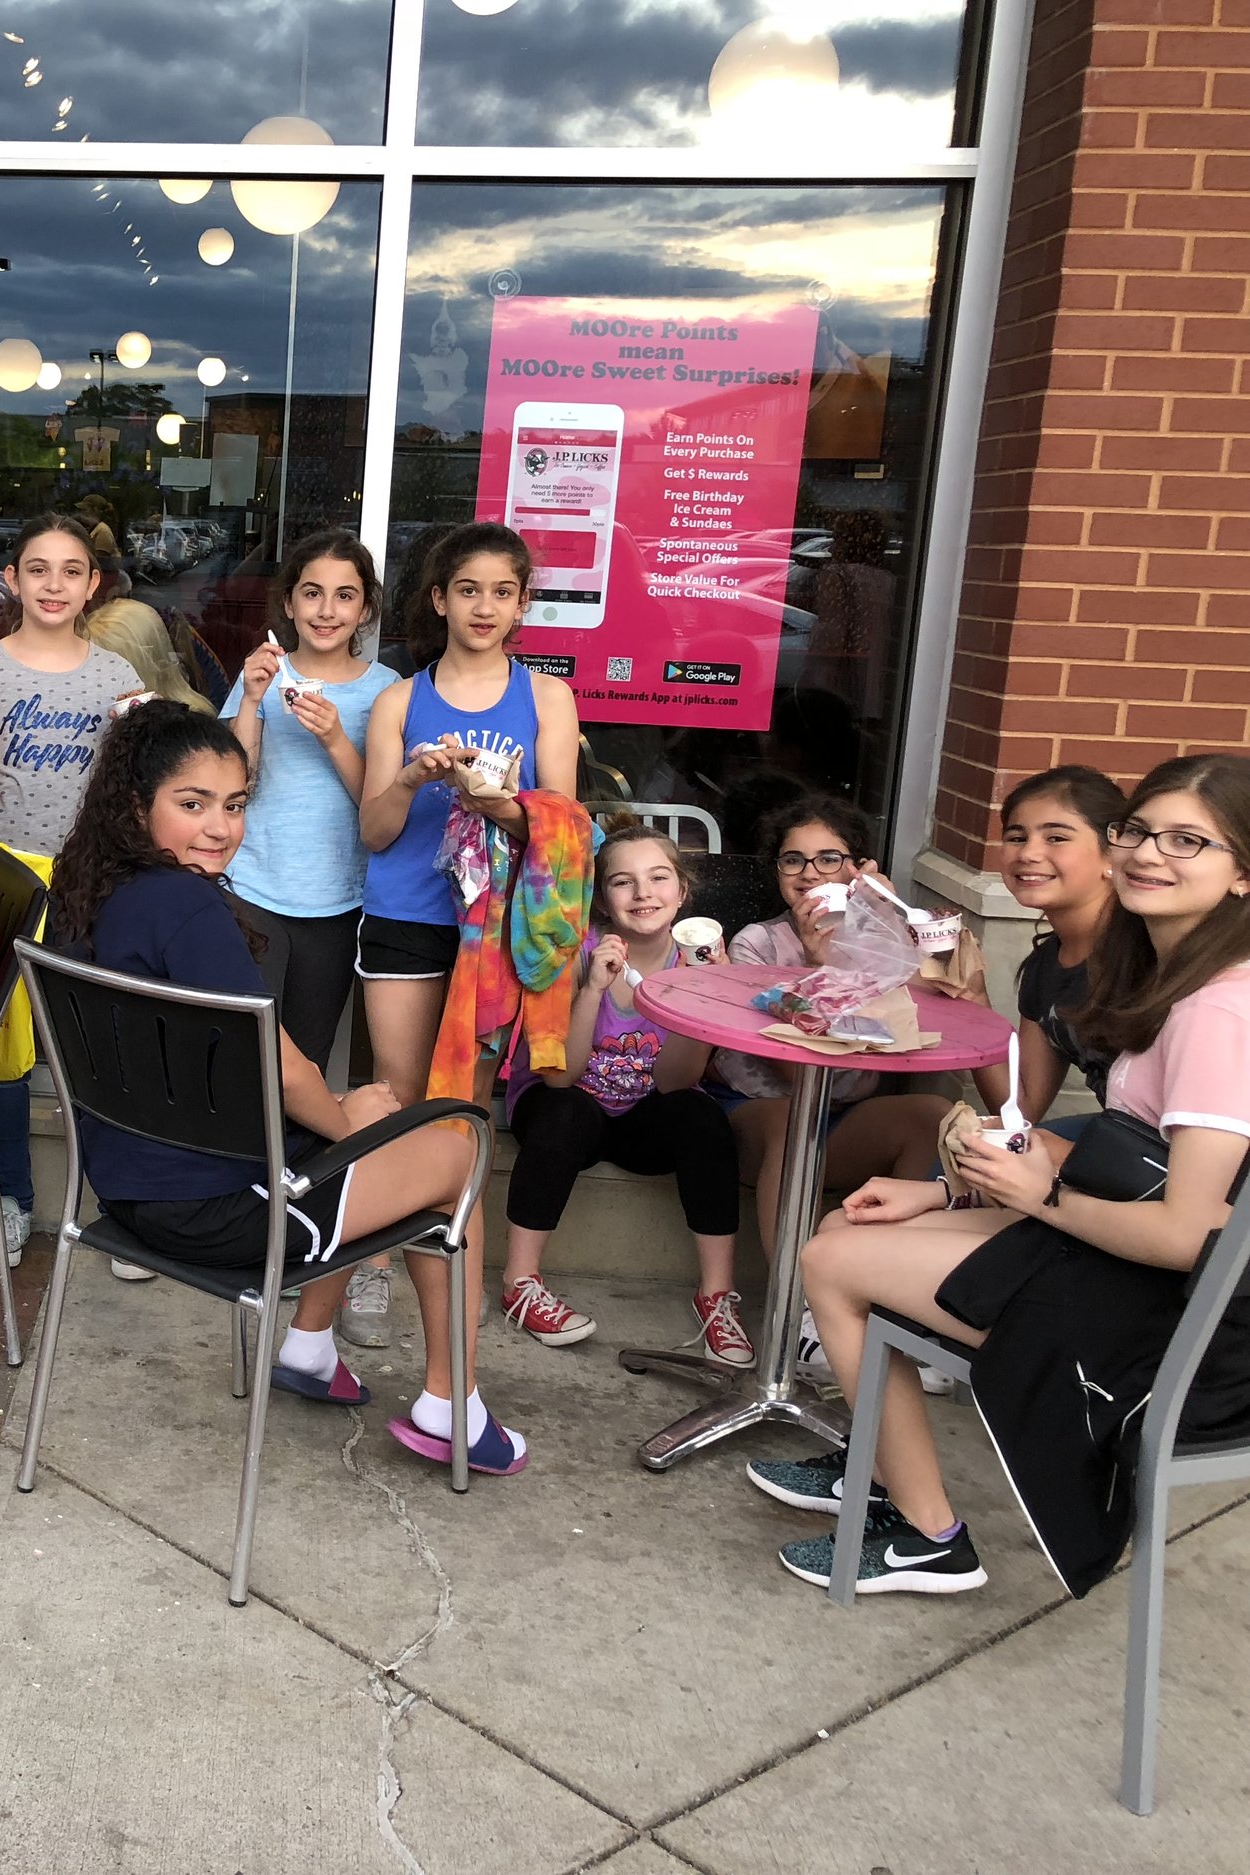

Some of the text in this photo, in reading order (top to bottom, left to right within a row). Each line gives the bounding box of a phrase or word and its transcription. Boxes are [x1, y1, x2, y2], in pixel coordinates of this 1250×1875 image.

[569, 319, 739, 341] MOOre Points
[618, 345, 684, 360] mean
[500, 359, 801, 387] MOOre Sweet Surprises!
[666, 431, 753, 446] Earn Points On
[572, 452, 608, 463] LICKS
[663, 445, 754, 459] Every Purchase
[664, 467, 749, 481] Get $ Rewards
[663, 489, 744, 505] Free Birthday
[673, 503, 731, 516] Ice Cream
[670, 516, 732, 529] & Sundaes
[659, 538, 738, 551] Spontaneous
[656, 551, 738, 565] Special Offers
[650, 572, 740, 586] Store Value For
[647, 586, 740, 600] Quick Checkout
[522, 656, 549, 664] Download
[522, 663, 569, 675] App Store
[685, 670, 736, 683] Google Play
[583, 689, 606, 700] Licks
[608, 690, 649, 702] Rewards
[651, 693, 670, 704] App
[672, 694, 682, 703] at
[683, 693, 738, 706] jplicks.com
[0, 693, 102, 741] Always
[3, 733, 95, 775] Happy
[932, 927, 957, 939] LICKS
